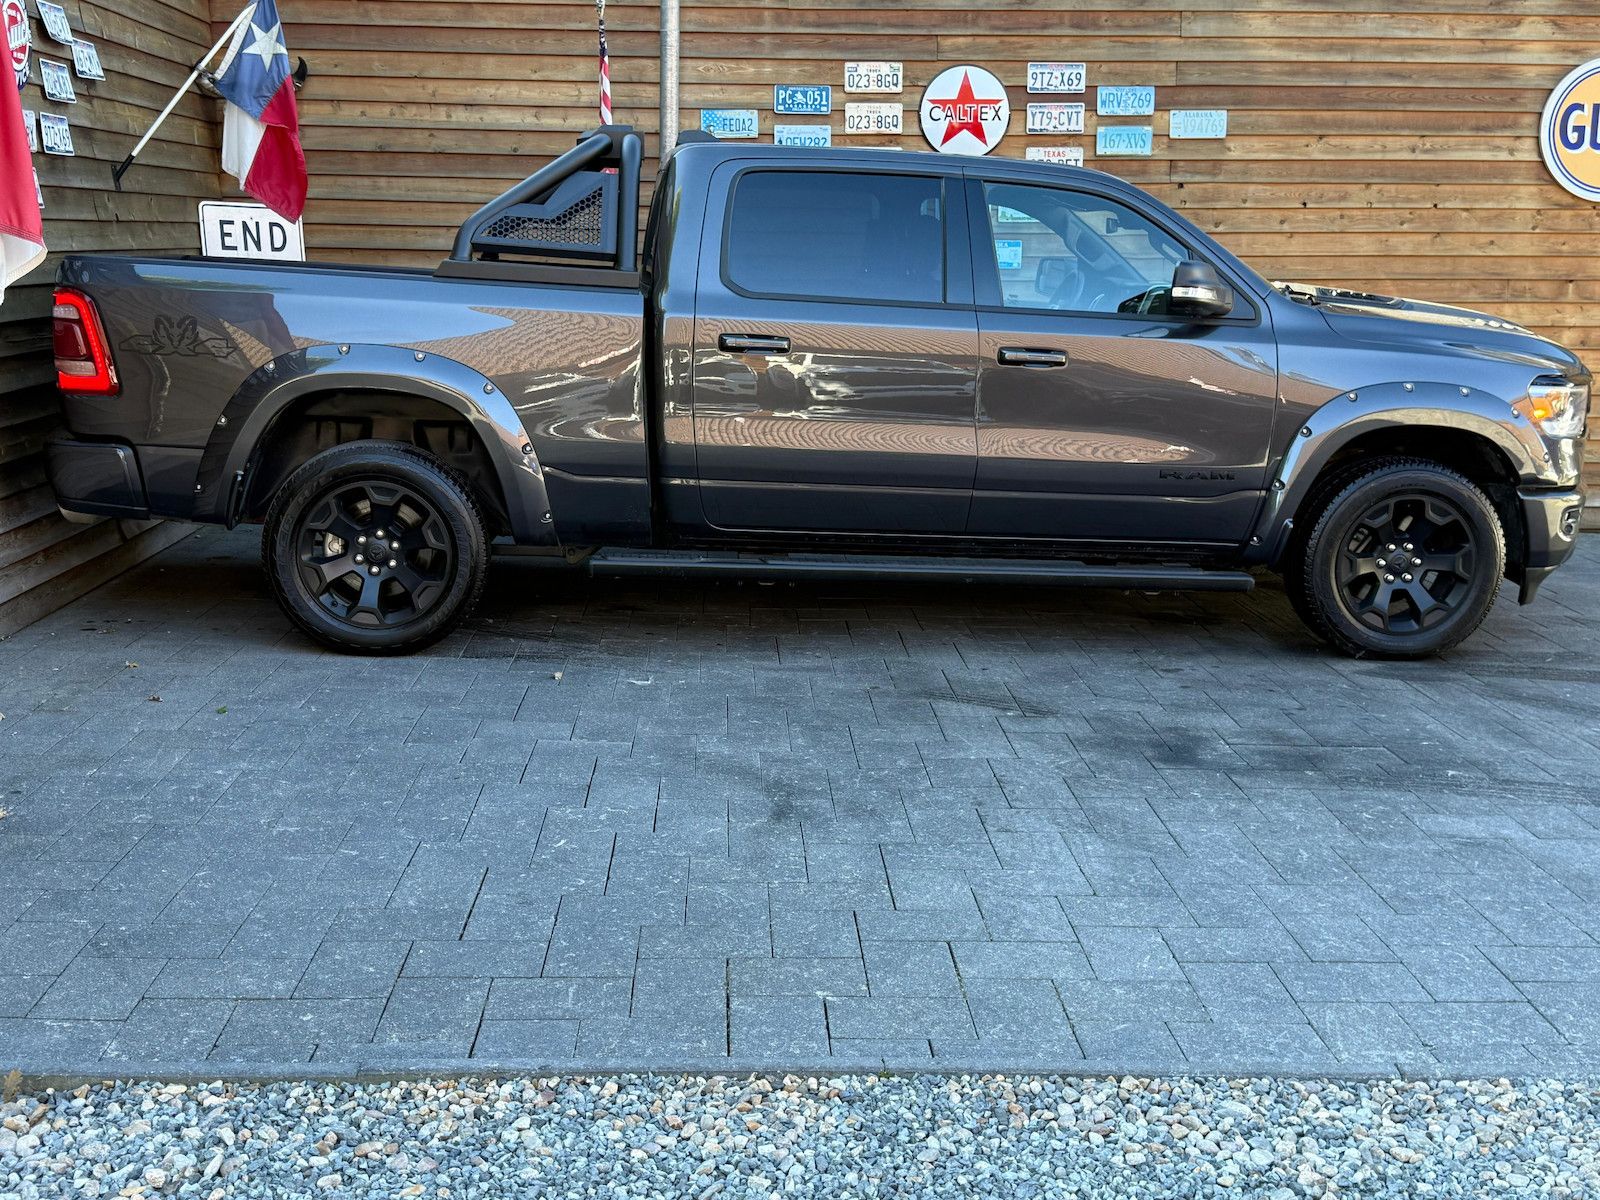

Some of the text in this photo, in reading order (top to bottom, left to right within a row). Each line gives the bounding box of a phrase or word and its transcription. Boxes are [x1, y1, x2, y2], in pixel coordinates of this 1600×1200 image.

[848, 74, 899, 88] 023 8GQ
[1031, 72, 1082, 87] 9TZ X69
[778, 90, 828, 105] PC 051
[1100, 92, 1151, 108] WRV 269
[929, 105, 1002, 122] CALTEX
[1030, 111, 1081, 126] Y79 CVT
[848, 115, 899, 129] 023 8GQ
[1043, 150, 1066, 158] TEXAS
[219, 219, 287, 252] END
